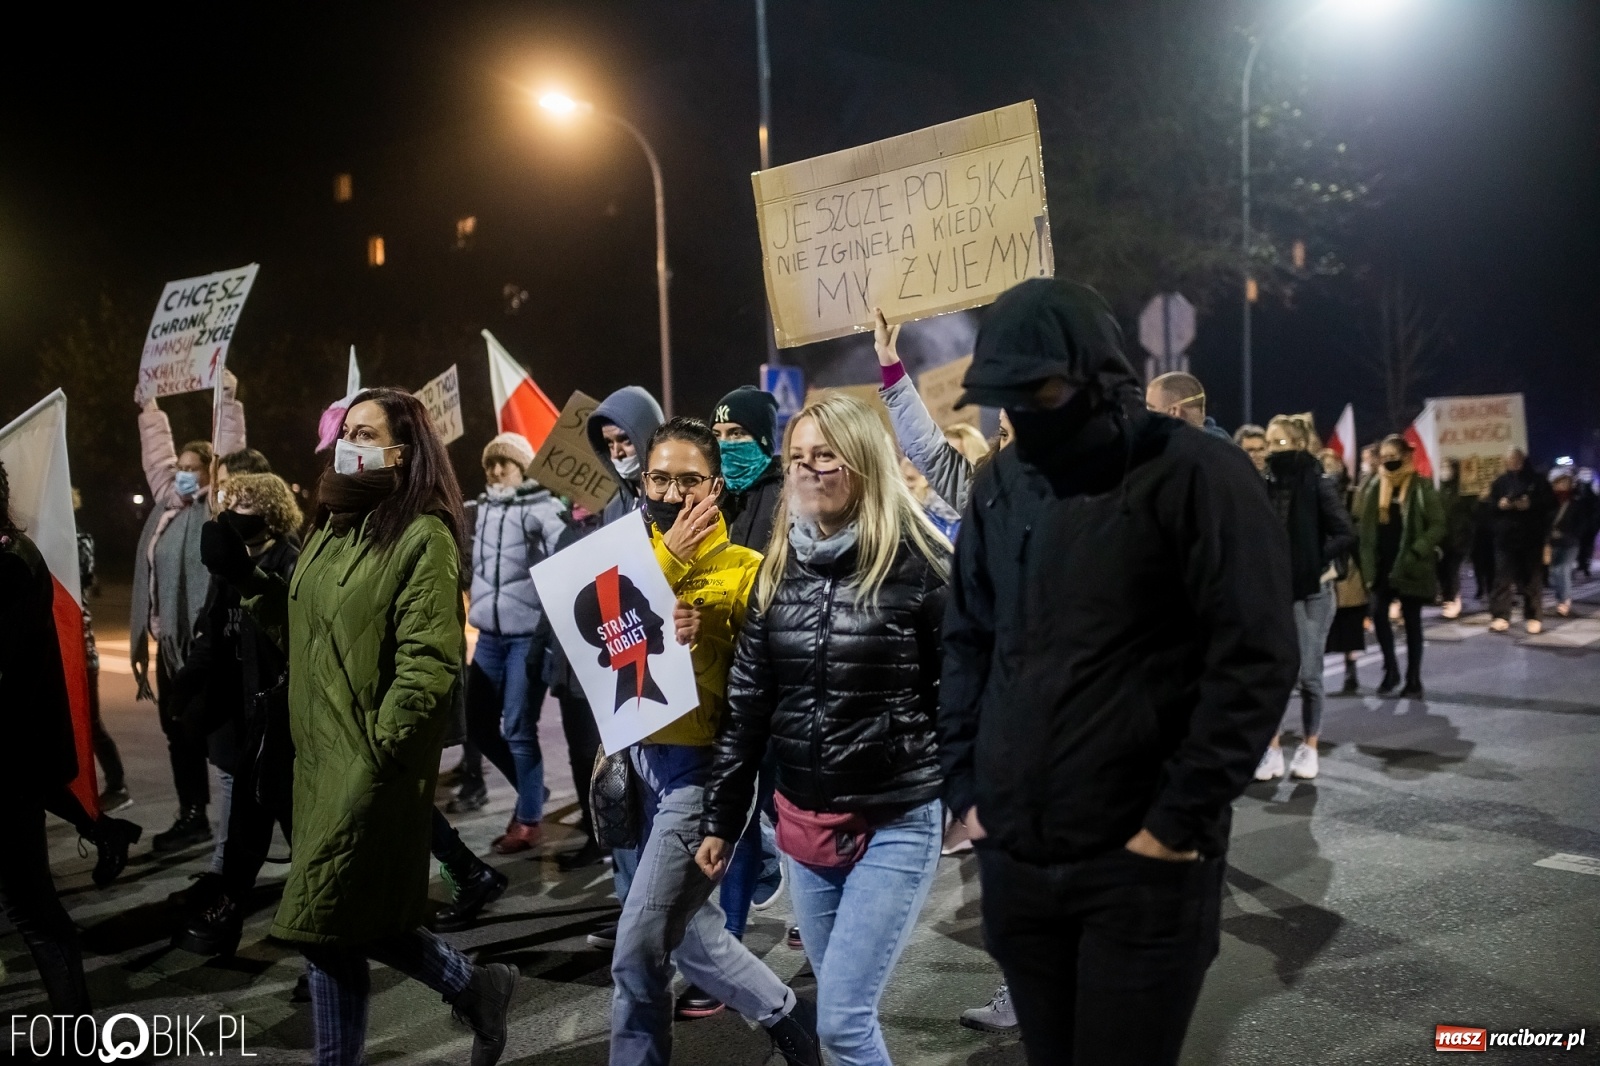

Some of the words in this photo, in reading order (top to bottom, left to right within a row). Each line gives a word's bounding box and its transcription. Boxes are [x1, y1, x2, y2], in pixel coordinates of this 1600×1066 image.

[773, 185, 894, 249] JESZCZE
[904, 155, 1035, 215] POLSKA
[777, 251, 809, 276] NIE
[932, 203, 996, 242] KIEDY
[164, 275, 247, 312] CHCESZ
[817, 267, 872, 319] MY
[714, 405, 730, 423] NY
[597, 608, 642, 641] STRAJK
[605, 625, 648, 657] KOBIET
